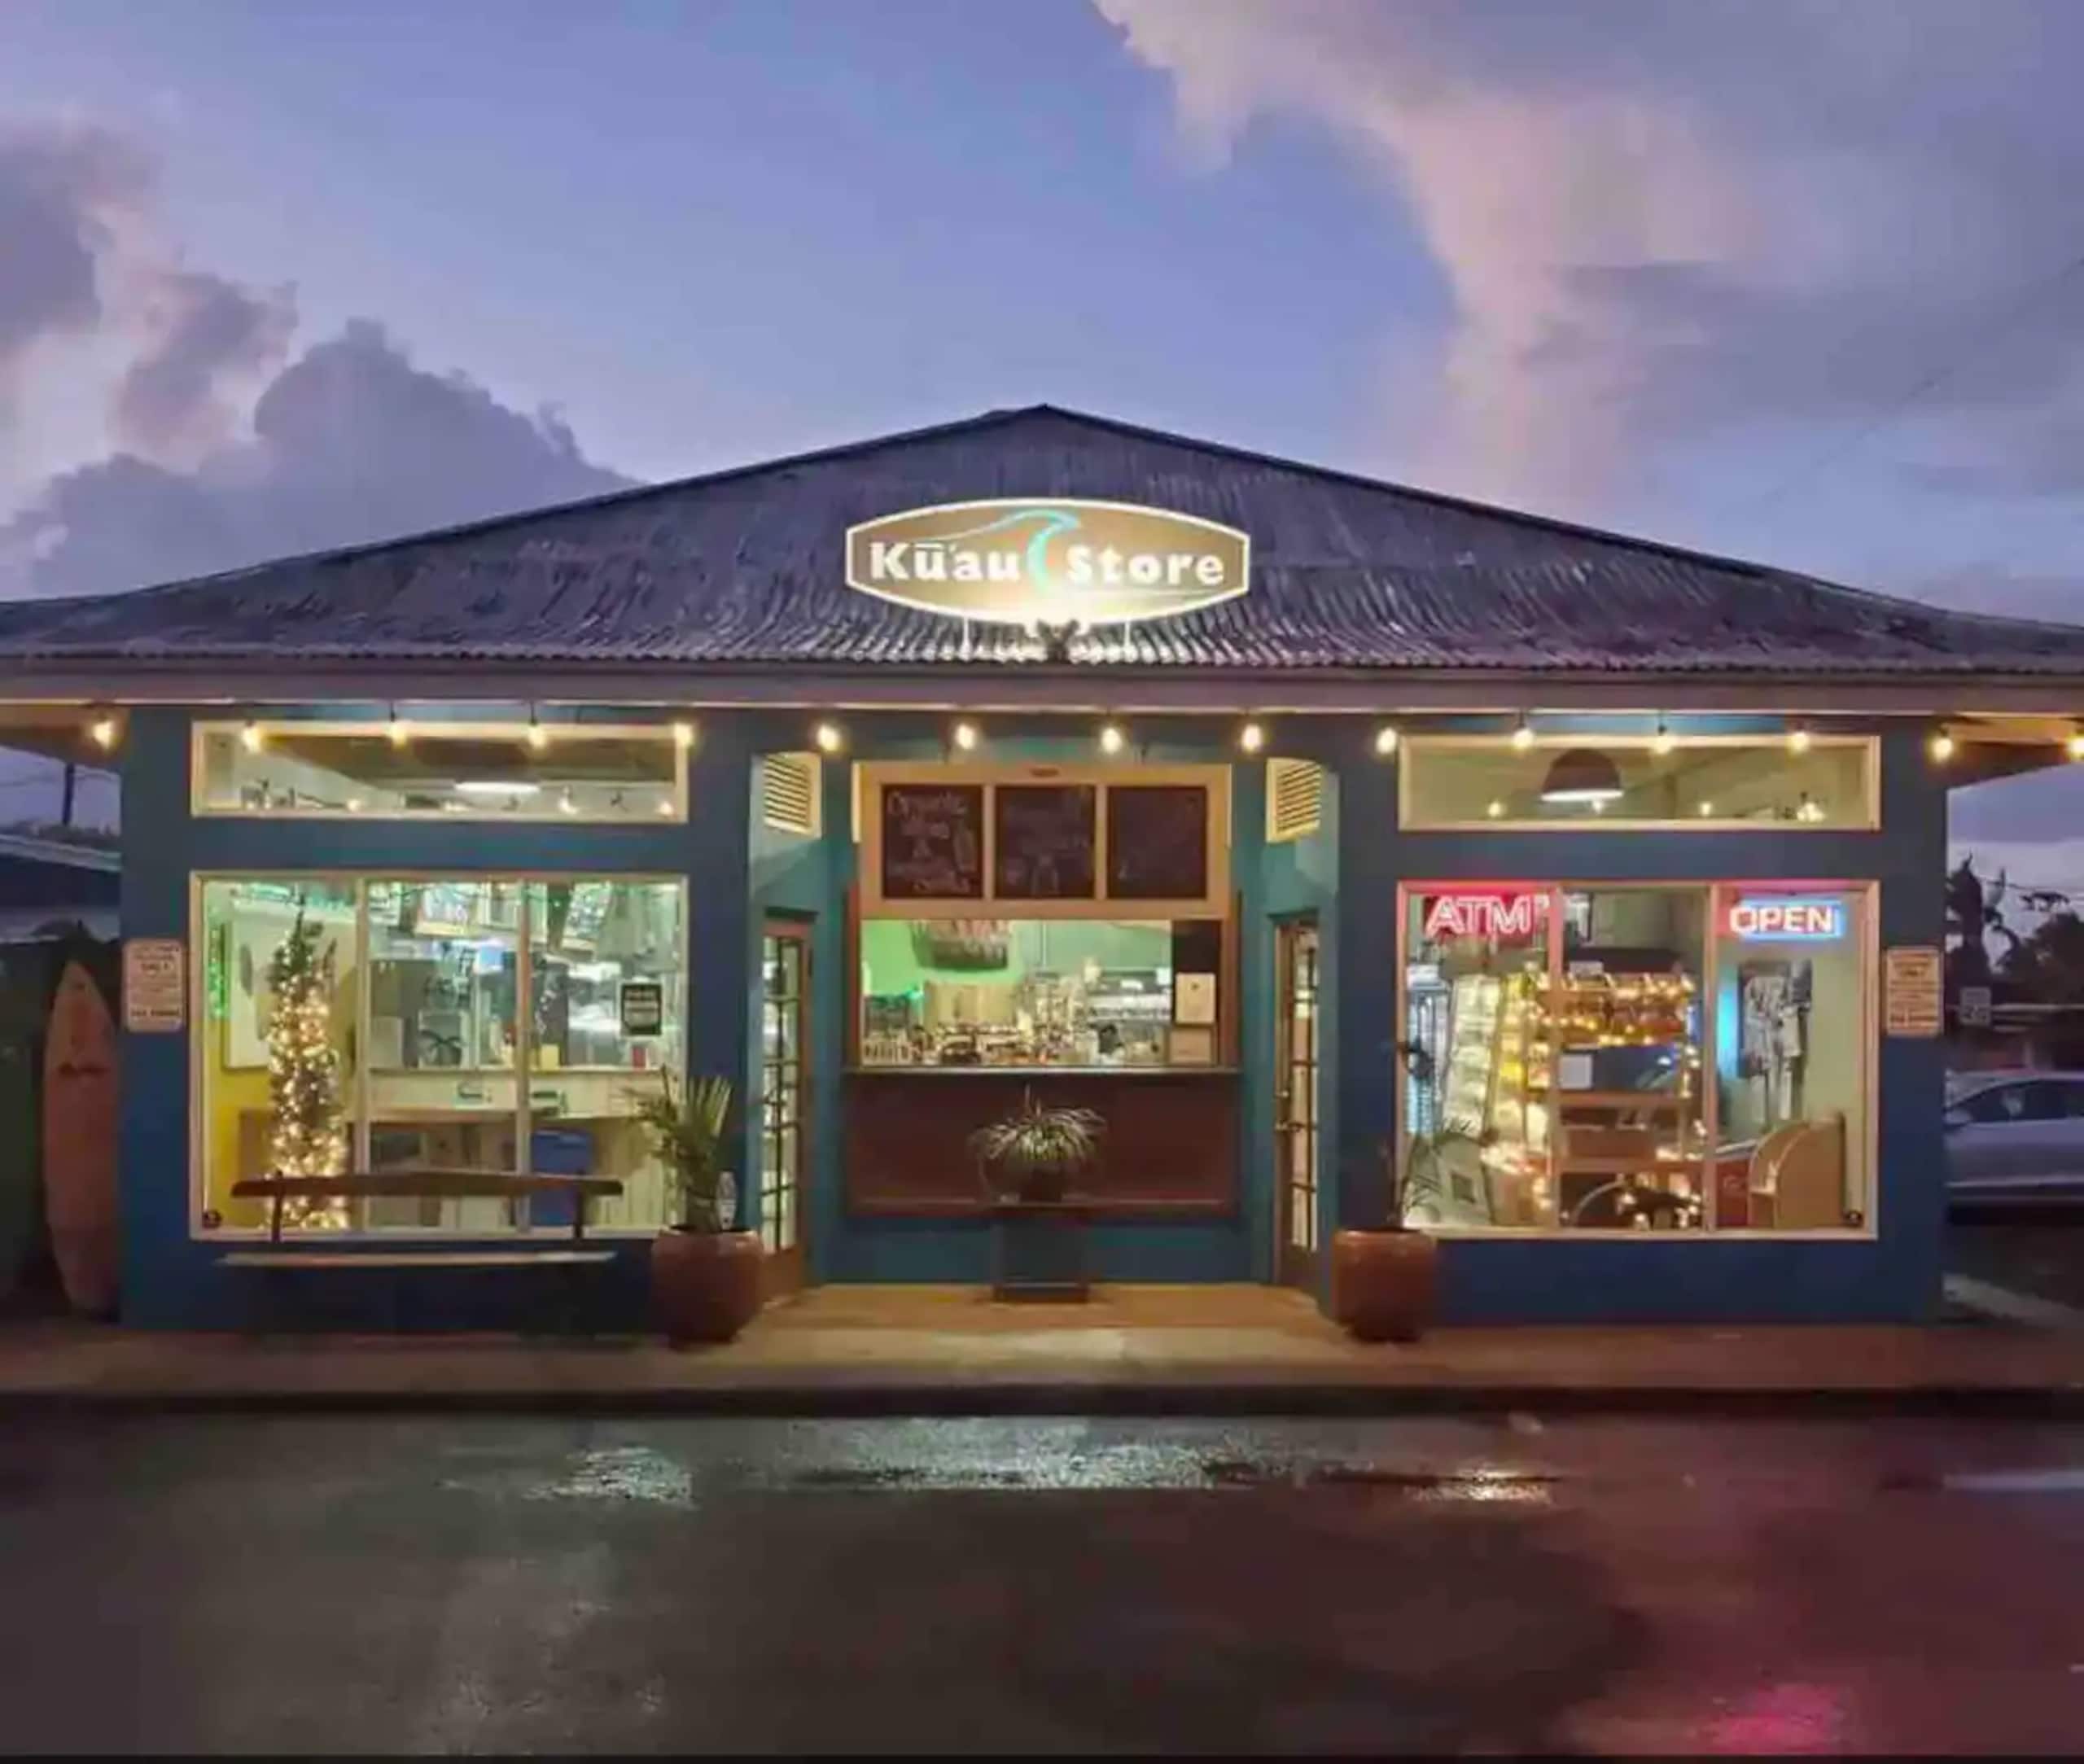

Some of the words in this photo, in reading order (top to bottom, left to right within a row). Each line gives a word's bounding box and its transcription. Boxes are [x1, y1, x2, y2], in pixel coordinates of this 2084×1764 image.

[1066, 545, 1224, 586] Store
[1425, 895, 1532, 937] ATM
[1730, 905, 1833, 934] OPEN
